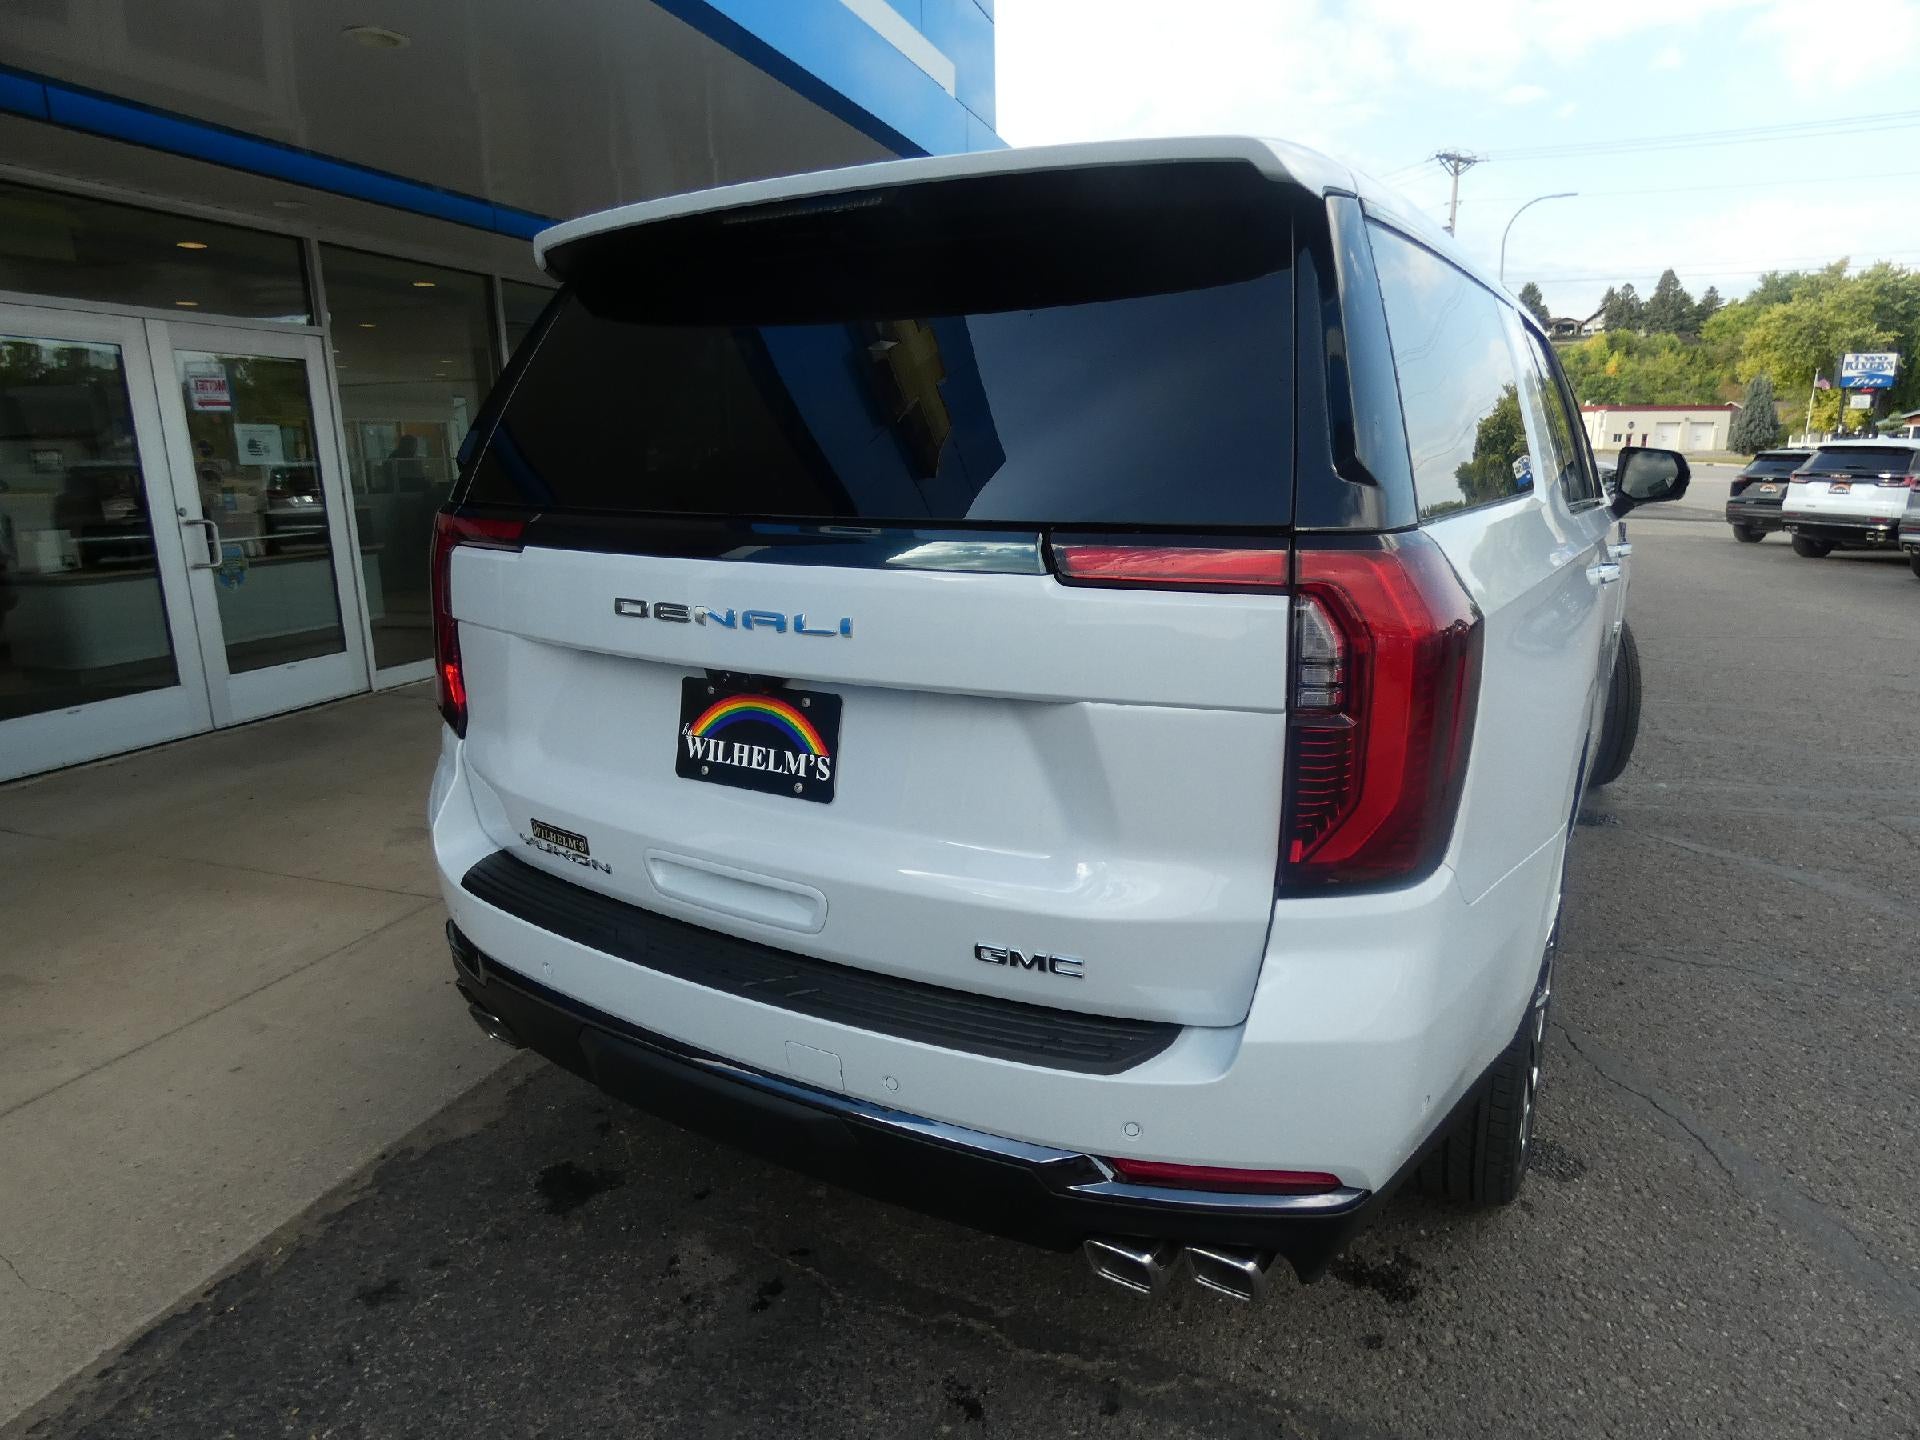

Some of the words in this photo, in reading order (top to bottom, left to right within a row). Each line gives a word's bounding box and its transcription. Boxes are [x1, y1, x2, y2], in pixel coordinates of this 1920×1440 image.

[1845, 361, 1894, 371] RIVERS
[614, 598, 853, 638] DENALI
[685, 735, 831, 782] WILHELM'S
[532, 823, 586, 852] WILHELM'S
[974, 942, 1085, 979] GMC
